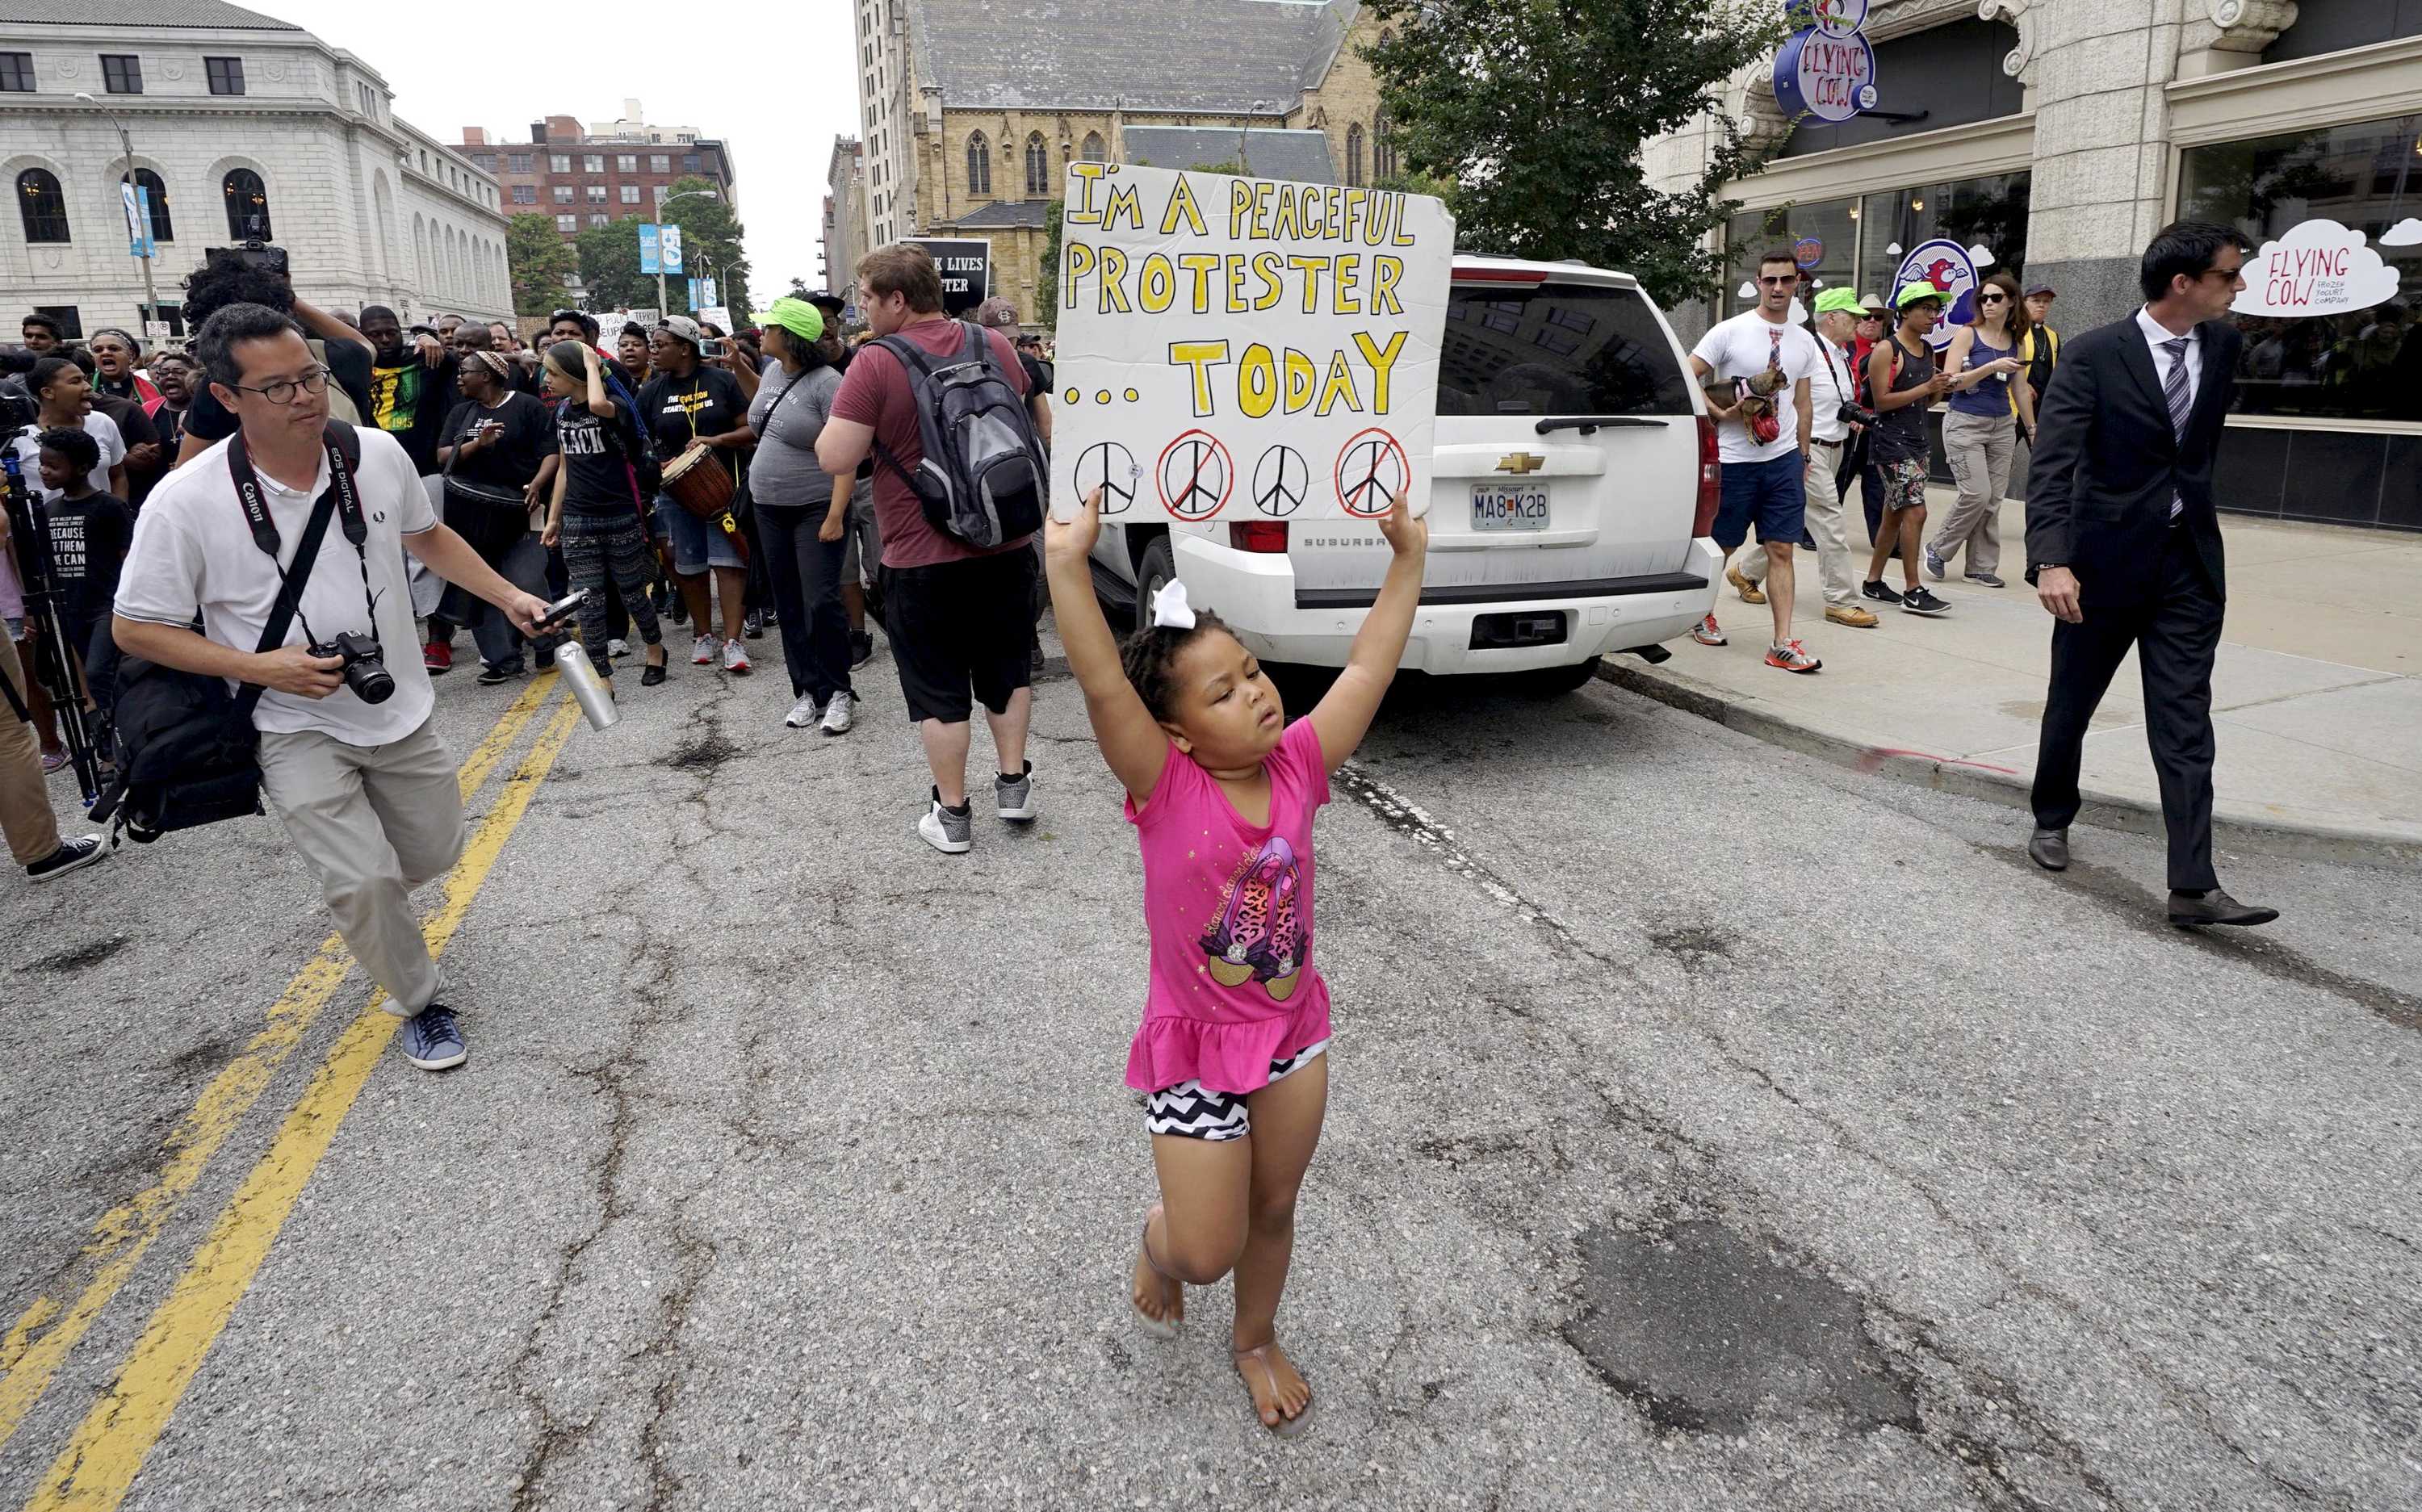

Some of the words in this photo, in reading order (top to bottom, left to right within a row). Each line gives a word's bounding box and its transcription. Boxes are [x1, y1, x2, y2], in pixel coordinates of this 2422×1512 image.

[1804, 43, 1867, 77] FLYING
[1816, 77, 1854, 107] COW
[1066, 162, 1144, 232] I'M
[1160, 172, 1209, 237] A
[1230, 178, 1414, 247] PEACEFUL
[661, 224, 682, 266] 150
[947, 258, 983, 271] LIVES
[2269, 247, 2349, 279] FLYING
[941, 279, 969, 292] TER
[1066, 241, 1404, 316] PROTESTER
[2318, 280, 2345, 288] FROZEN
[2265, 279, 2315, 307] COW
[2314, 296, 2349, 304] COMPANY
[2316, 288, 2345, 296] YOGURT
[1168, 331, 1410, 419] TODAY
[668, 395, 679, 404] THE
[704, 399, 714, 407] US
[392, 417, 413, 428] 1945
[332, 447, 344, 470] EOS
[242, 482, 264, 522] Canon
[337, 472, 355, 514] DIGITAL
[1475, 494, 1506, 518] MA8
[1515, 494, 1546, 518] K2B
[60, 540, 86, 552] THEM
[1304, 538, 1386, 547] SUBURBA
[64, 554, 86, 565] CAN
